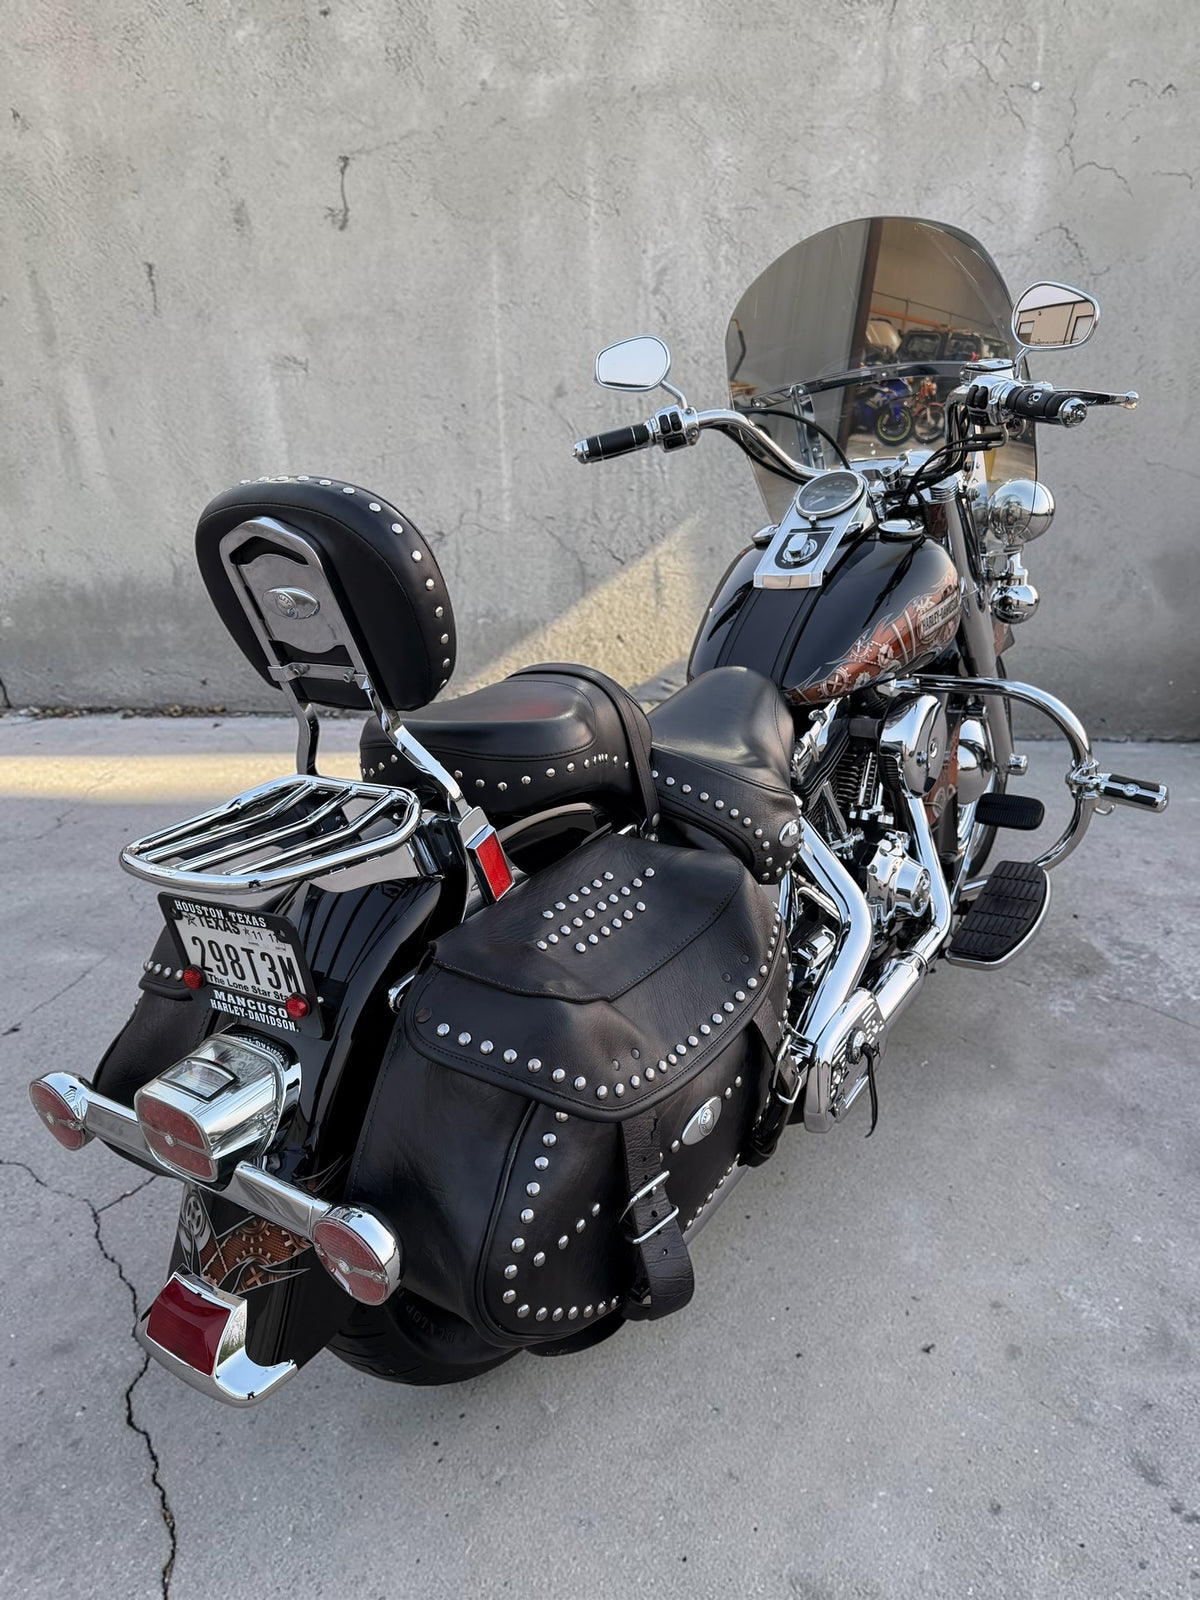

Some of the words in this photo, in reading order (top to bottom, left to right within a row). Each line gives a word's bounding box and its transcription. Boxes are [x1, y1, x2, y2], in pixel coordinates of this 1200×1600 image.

[199, 915, 241, 935] TEXAS
[229, 911, 267, 928] TEXAS
[191, 936, 301, 994] 298T3M
[207, 974, 225, 985] The
[226, 979, 250, 992] Lone
[251, 985, 271, 998] Star
[273, 991, 290, 1002] Sta
[213, 989, 289, 1019] MANCUSO
